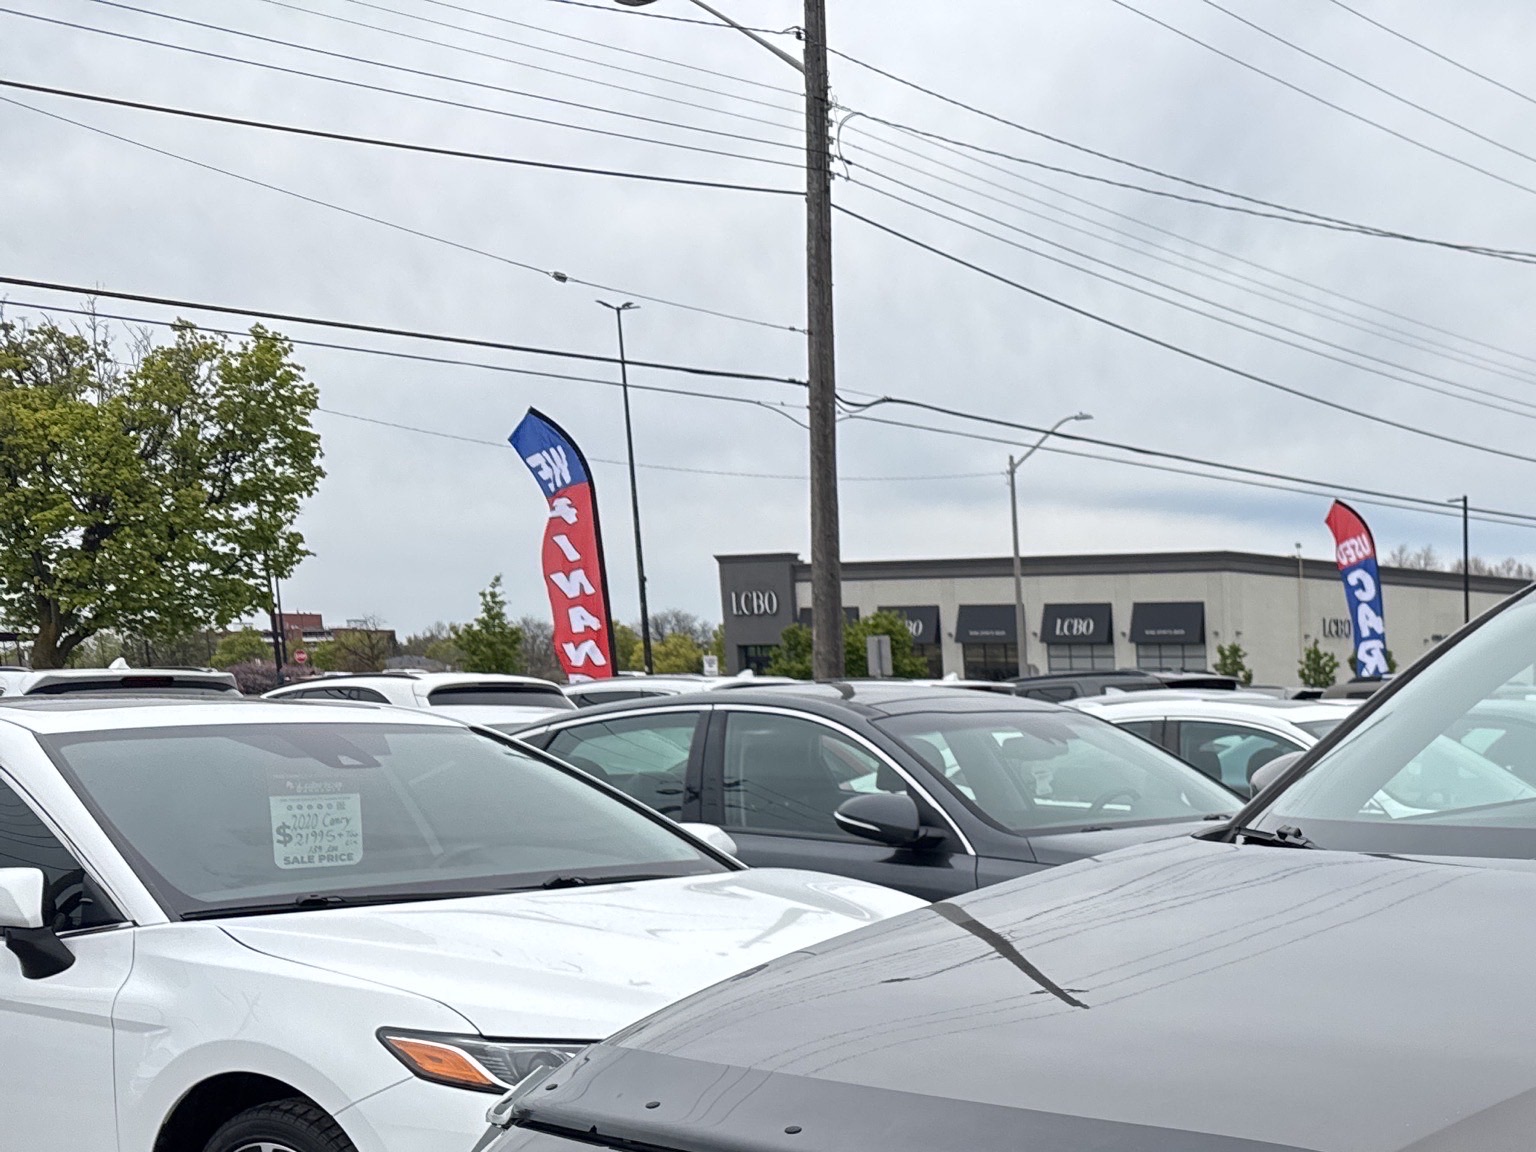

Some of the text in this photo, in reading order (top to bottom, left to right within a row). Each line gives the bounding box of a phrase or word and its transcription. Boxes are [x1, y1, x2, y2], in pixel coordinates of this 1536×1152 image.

[731, 590, 778, 617] LCBO
[904, 619, 924, 637] BO
[1055, 617, 1095, 636] LCBO
[1322, 617, 1352, 638] LCBO
[291, 813, 318, 832] 2020
[276, 821, 293, 847] $
[283, 853, 354, 865] SALE PRICE
